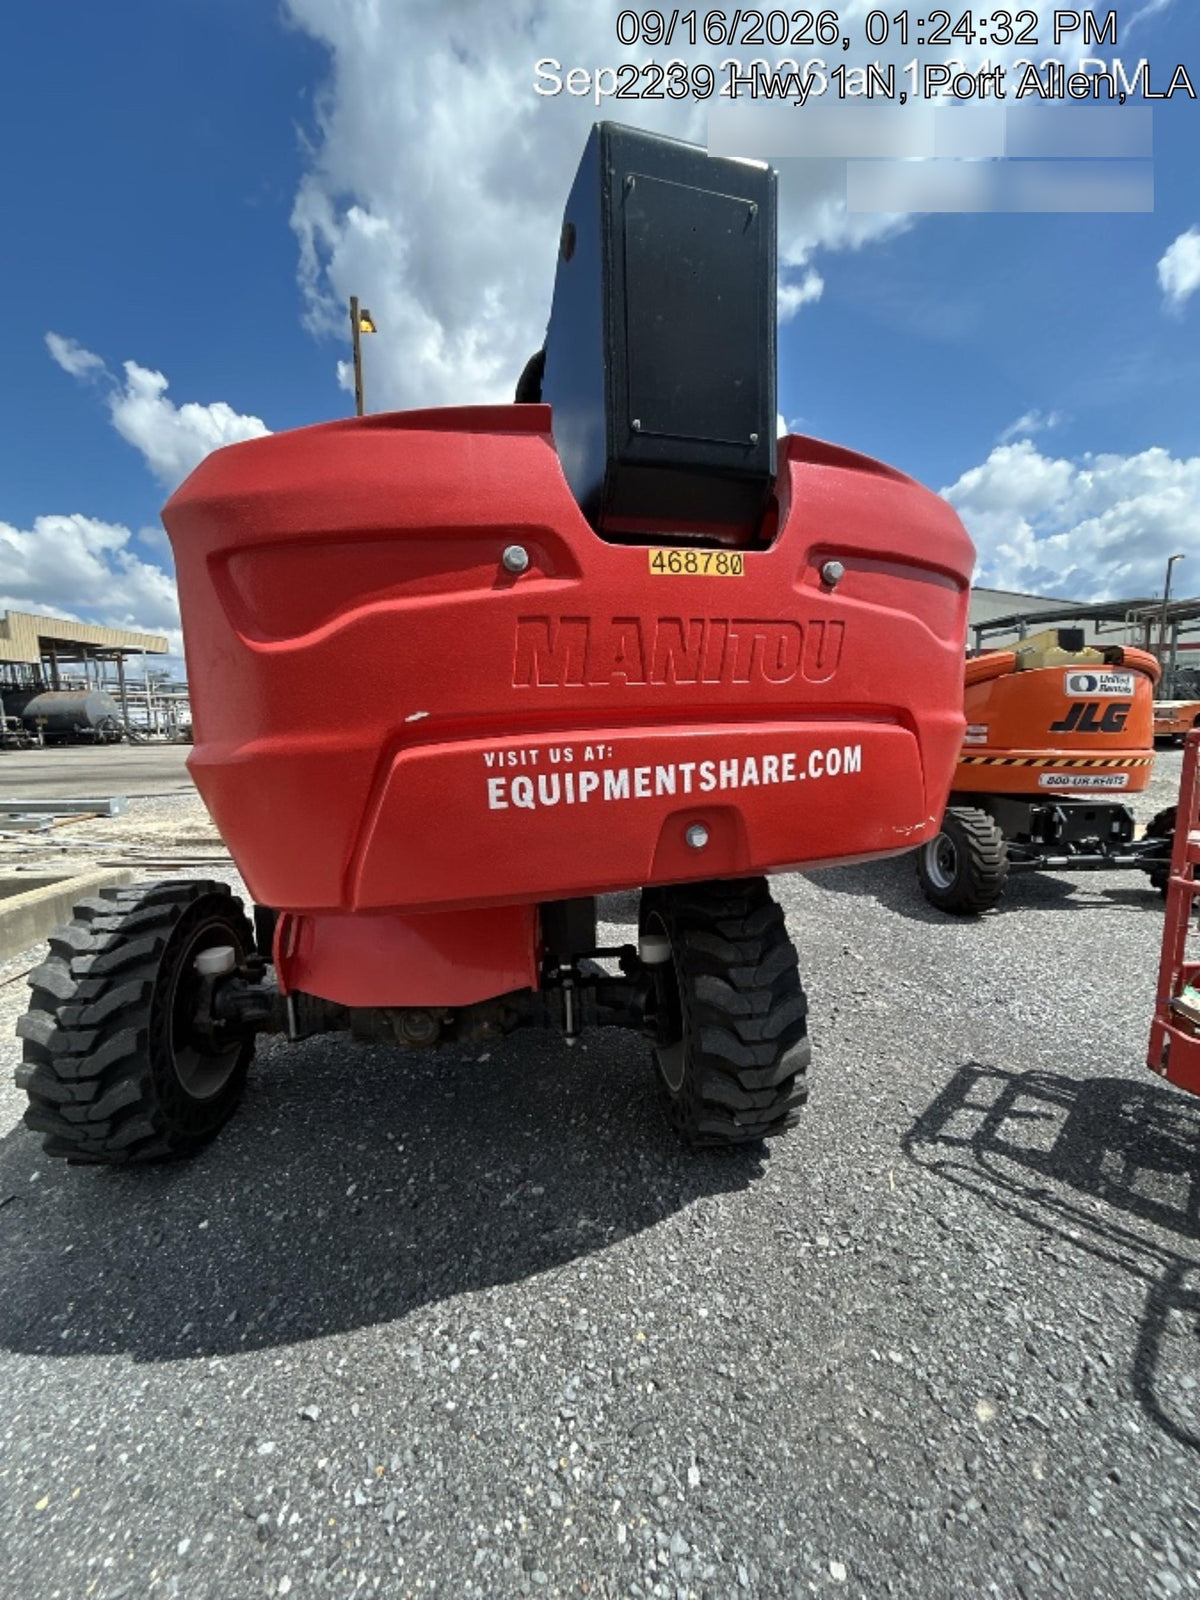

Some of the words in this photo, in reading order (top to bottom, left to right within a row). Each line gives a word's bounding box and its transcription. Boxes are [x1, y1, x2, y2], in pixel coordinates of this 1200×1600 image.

[652, 550, 742, 574] 468780
[512, 616, 845, 688] MANITOU
[1049, 703, 1132, 732] JLG
[483, 750, 539, 767] VISIT
[549, 747, 574, 763] US
[584, 744, 613, 761] AT:
[487, 745, 863, 810] EQUIPMENTSHARE.COM
